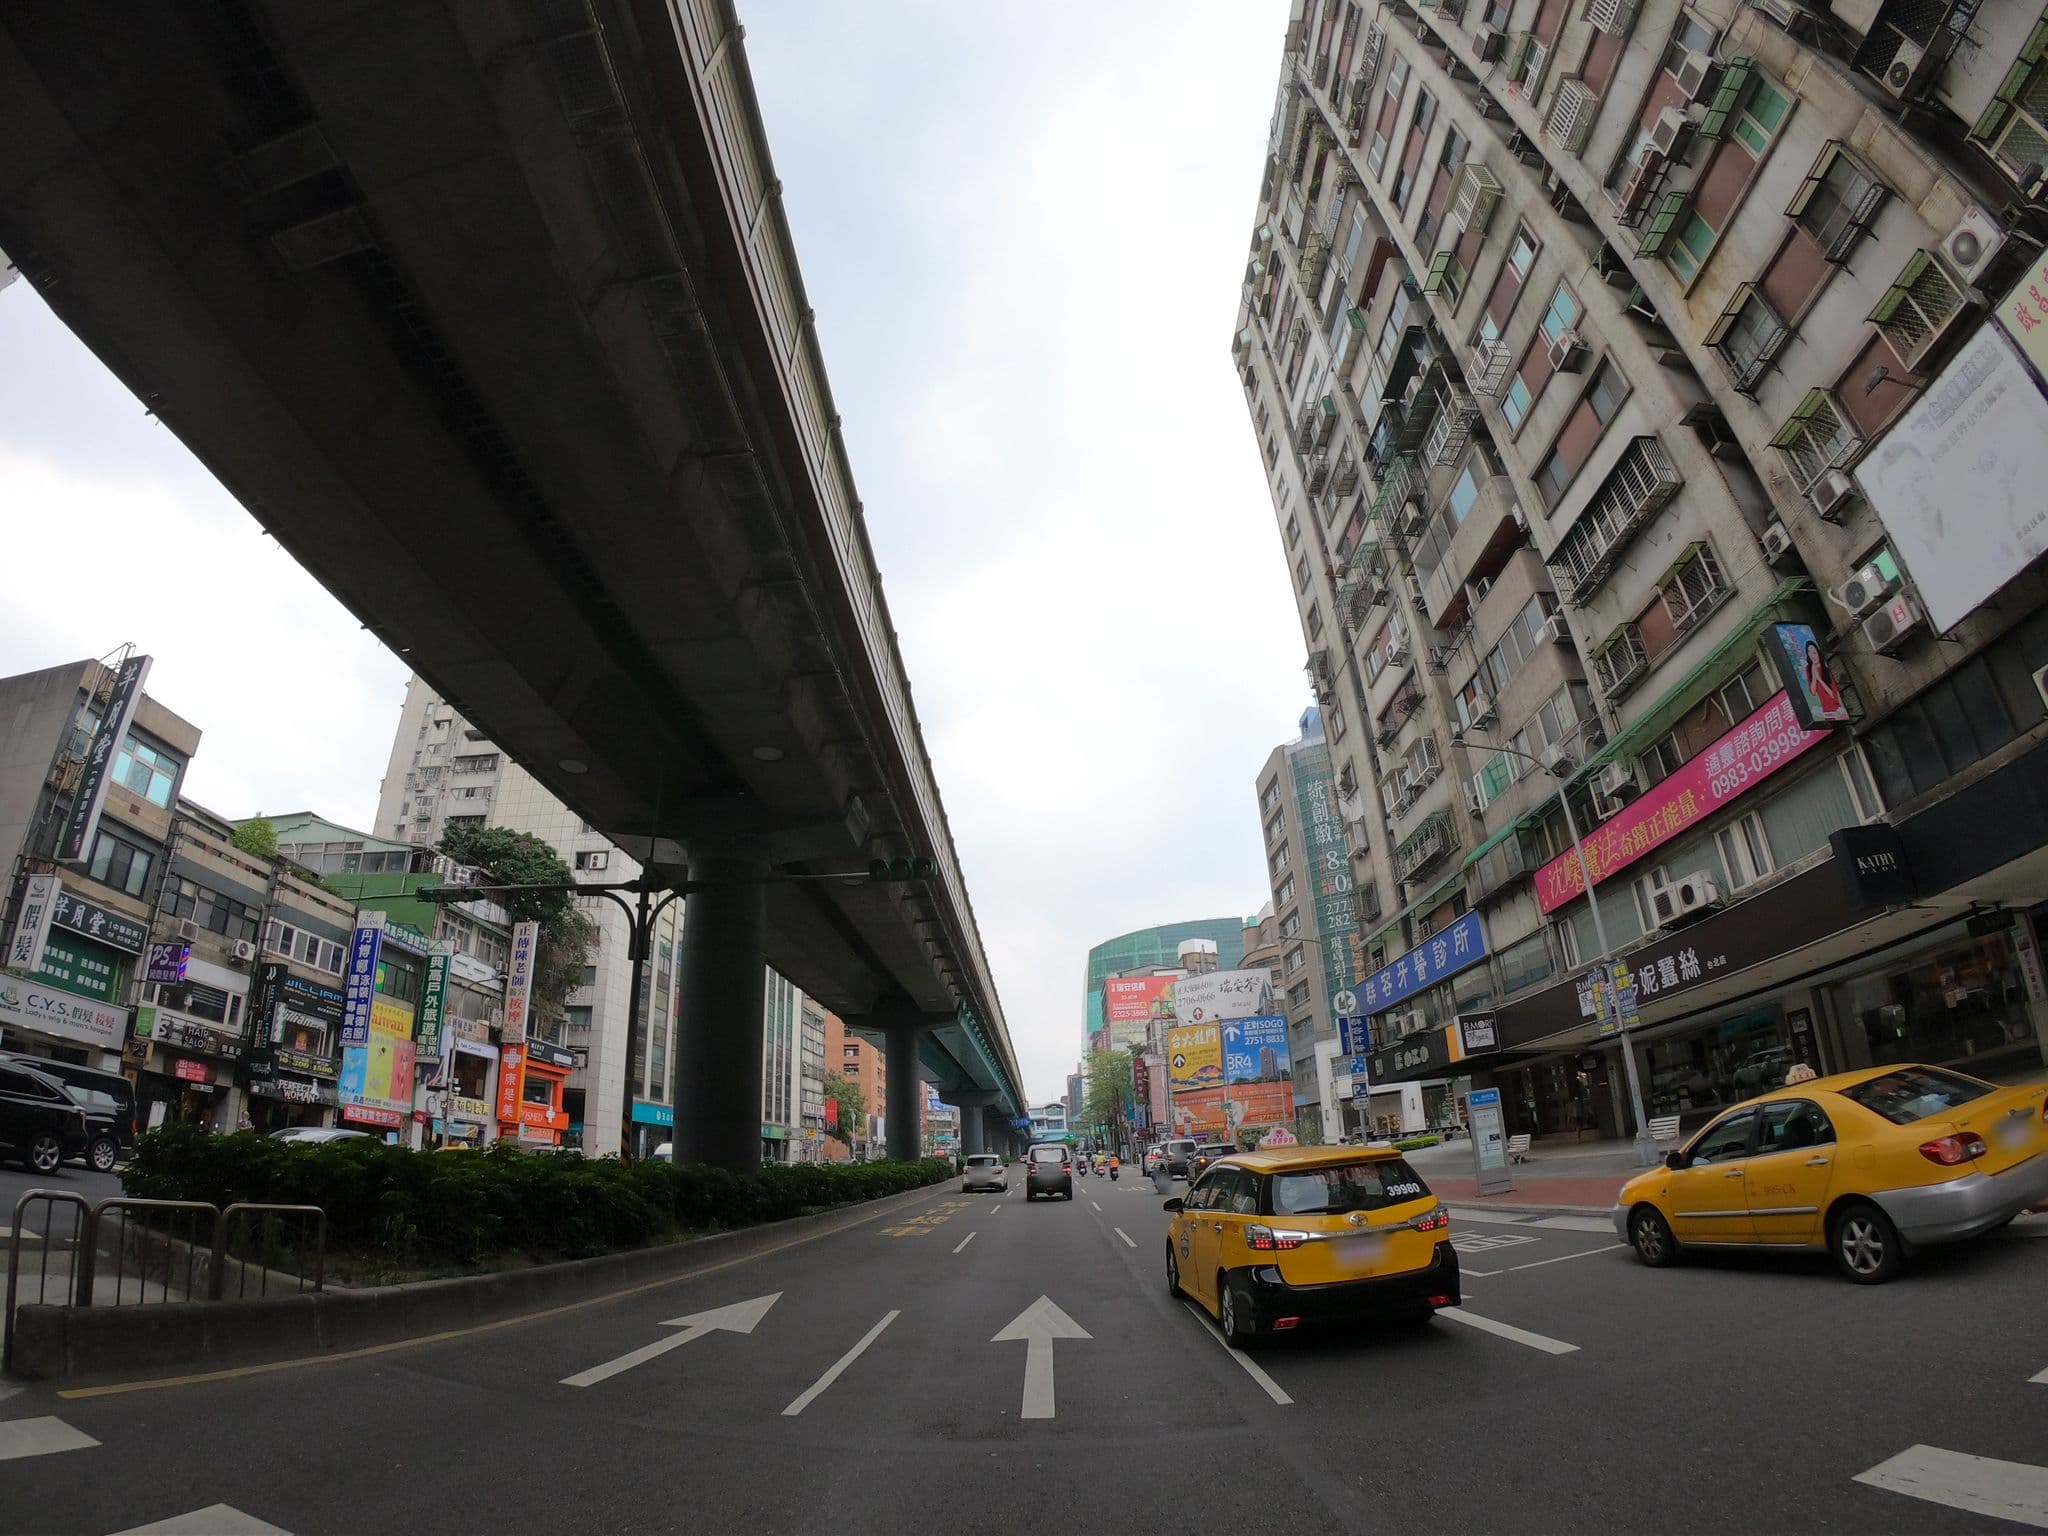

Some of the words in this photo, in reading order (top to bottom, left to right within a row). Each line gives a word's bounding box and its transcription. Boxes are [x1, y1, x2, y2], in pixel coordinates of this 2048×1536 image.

[1857, 853, 1895, 869] KATHY
[14, 904, 41, 961] 假髮
[151, 945, 172, 965] PS
[1366, 923, 1469, 1005] 群容牙醫診所
[28, 994, 70, 1017] C.Y.S.
[508, 998, 522, 1022] 按摩
[188, 1025, 209, 1038] HAIR
[184, 1036, 209, 1049] SALON
[1227, 1055, 1252, 1070] BR4
[279, 1080, 313, 1091] PERFECT
[284, 1089, 316, 1103] WOMAN
[502, 1073, 516, 1117] 康是美
[1387, 1183, 1420, 1196] 39980
